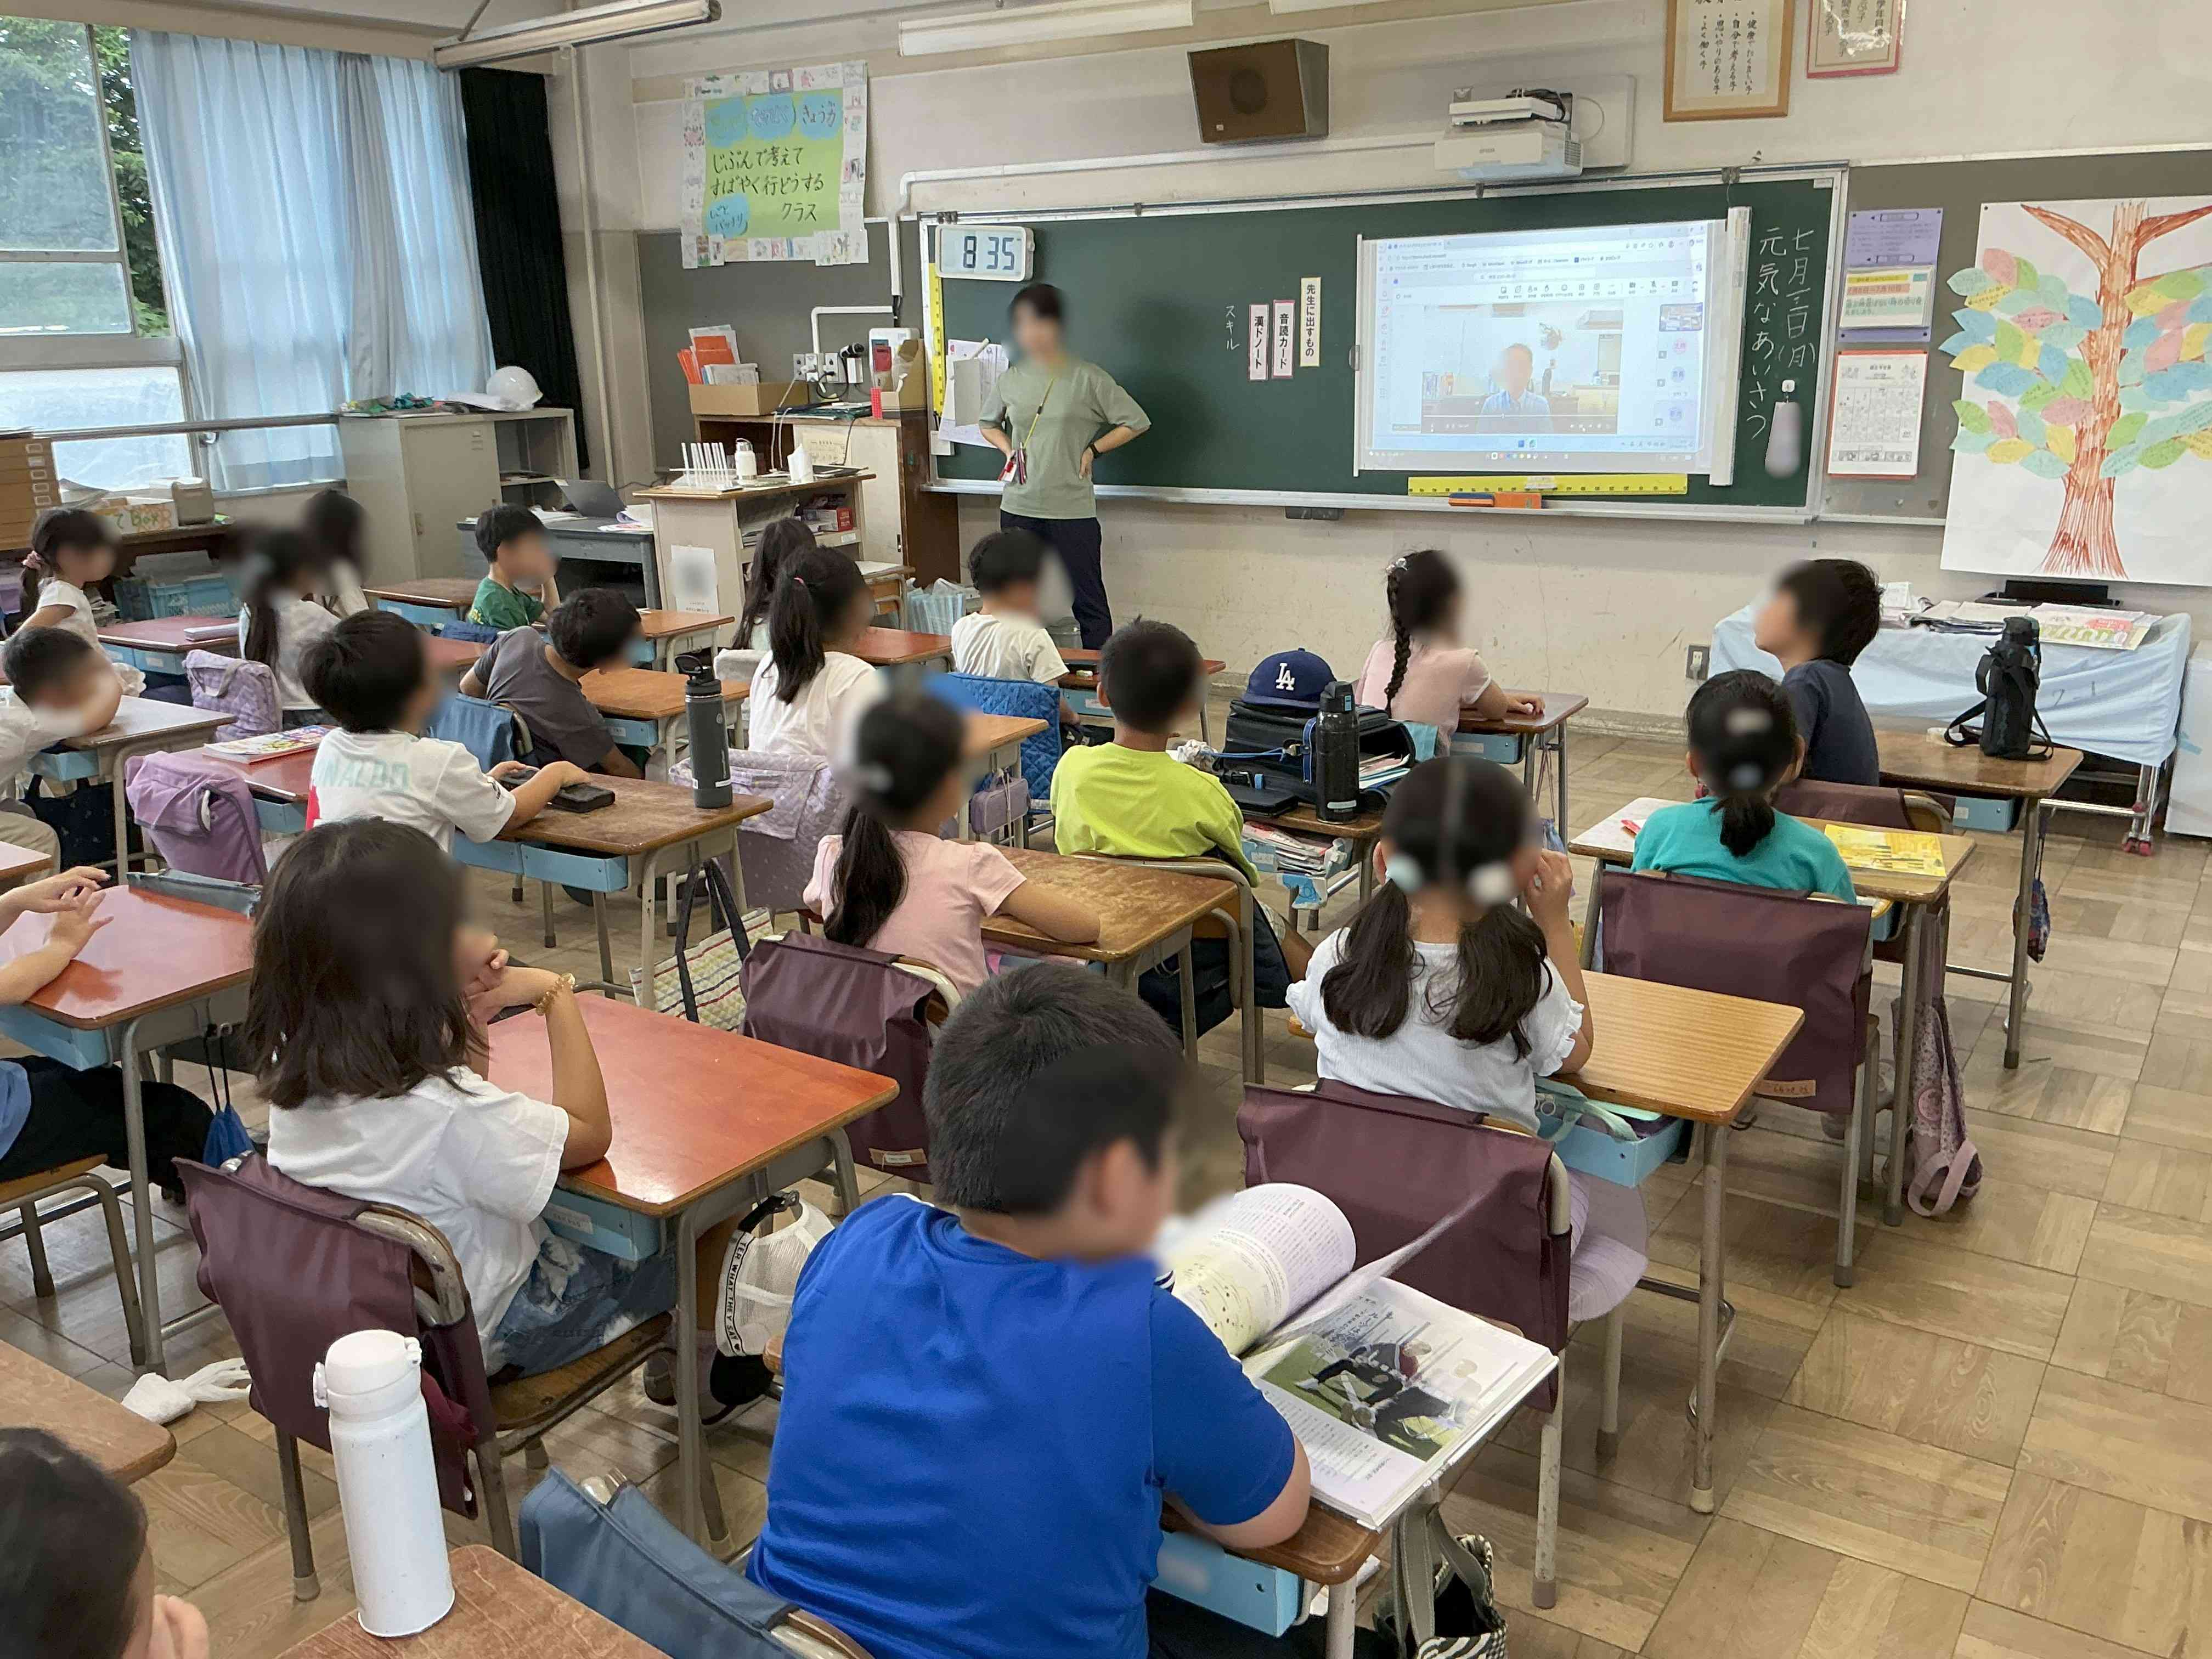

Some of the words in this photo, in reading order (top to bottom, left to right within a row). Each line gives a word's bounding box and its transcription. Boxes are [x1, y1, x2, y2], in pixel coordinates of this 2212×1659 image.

[713, 146, 804, 174] じぶんで考えて
[709, 172, 825, 198] すばやく行どうする
[781, 202, 818, 222] クラス
[986, 236, 1015, 270] 35
[1225, 305, 1241, 352] スキル
[1305, 284, 1316, 357] 先生に出すもの
[1746, 226, 1787, 440] 元気なあいさつ
[1254, 315, 1265, 370] 漢ドノート
[1279, 313, 1289, 370] 音読カード
[1275, 662, 1295, 691] LA
[726, 1264, 738, 1293] WHAT
[726, 1296, 735, 1323] THEY
[727, 1324, 738, 1341] SAY
